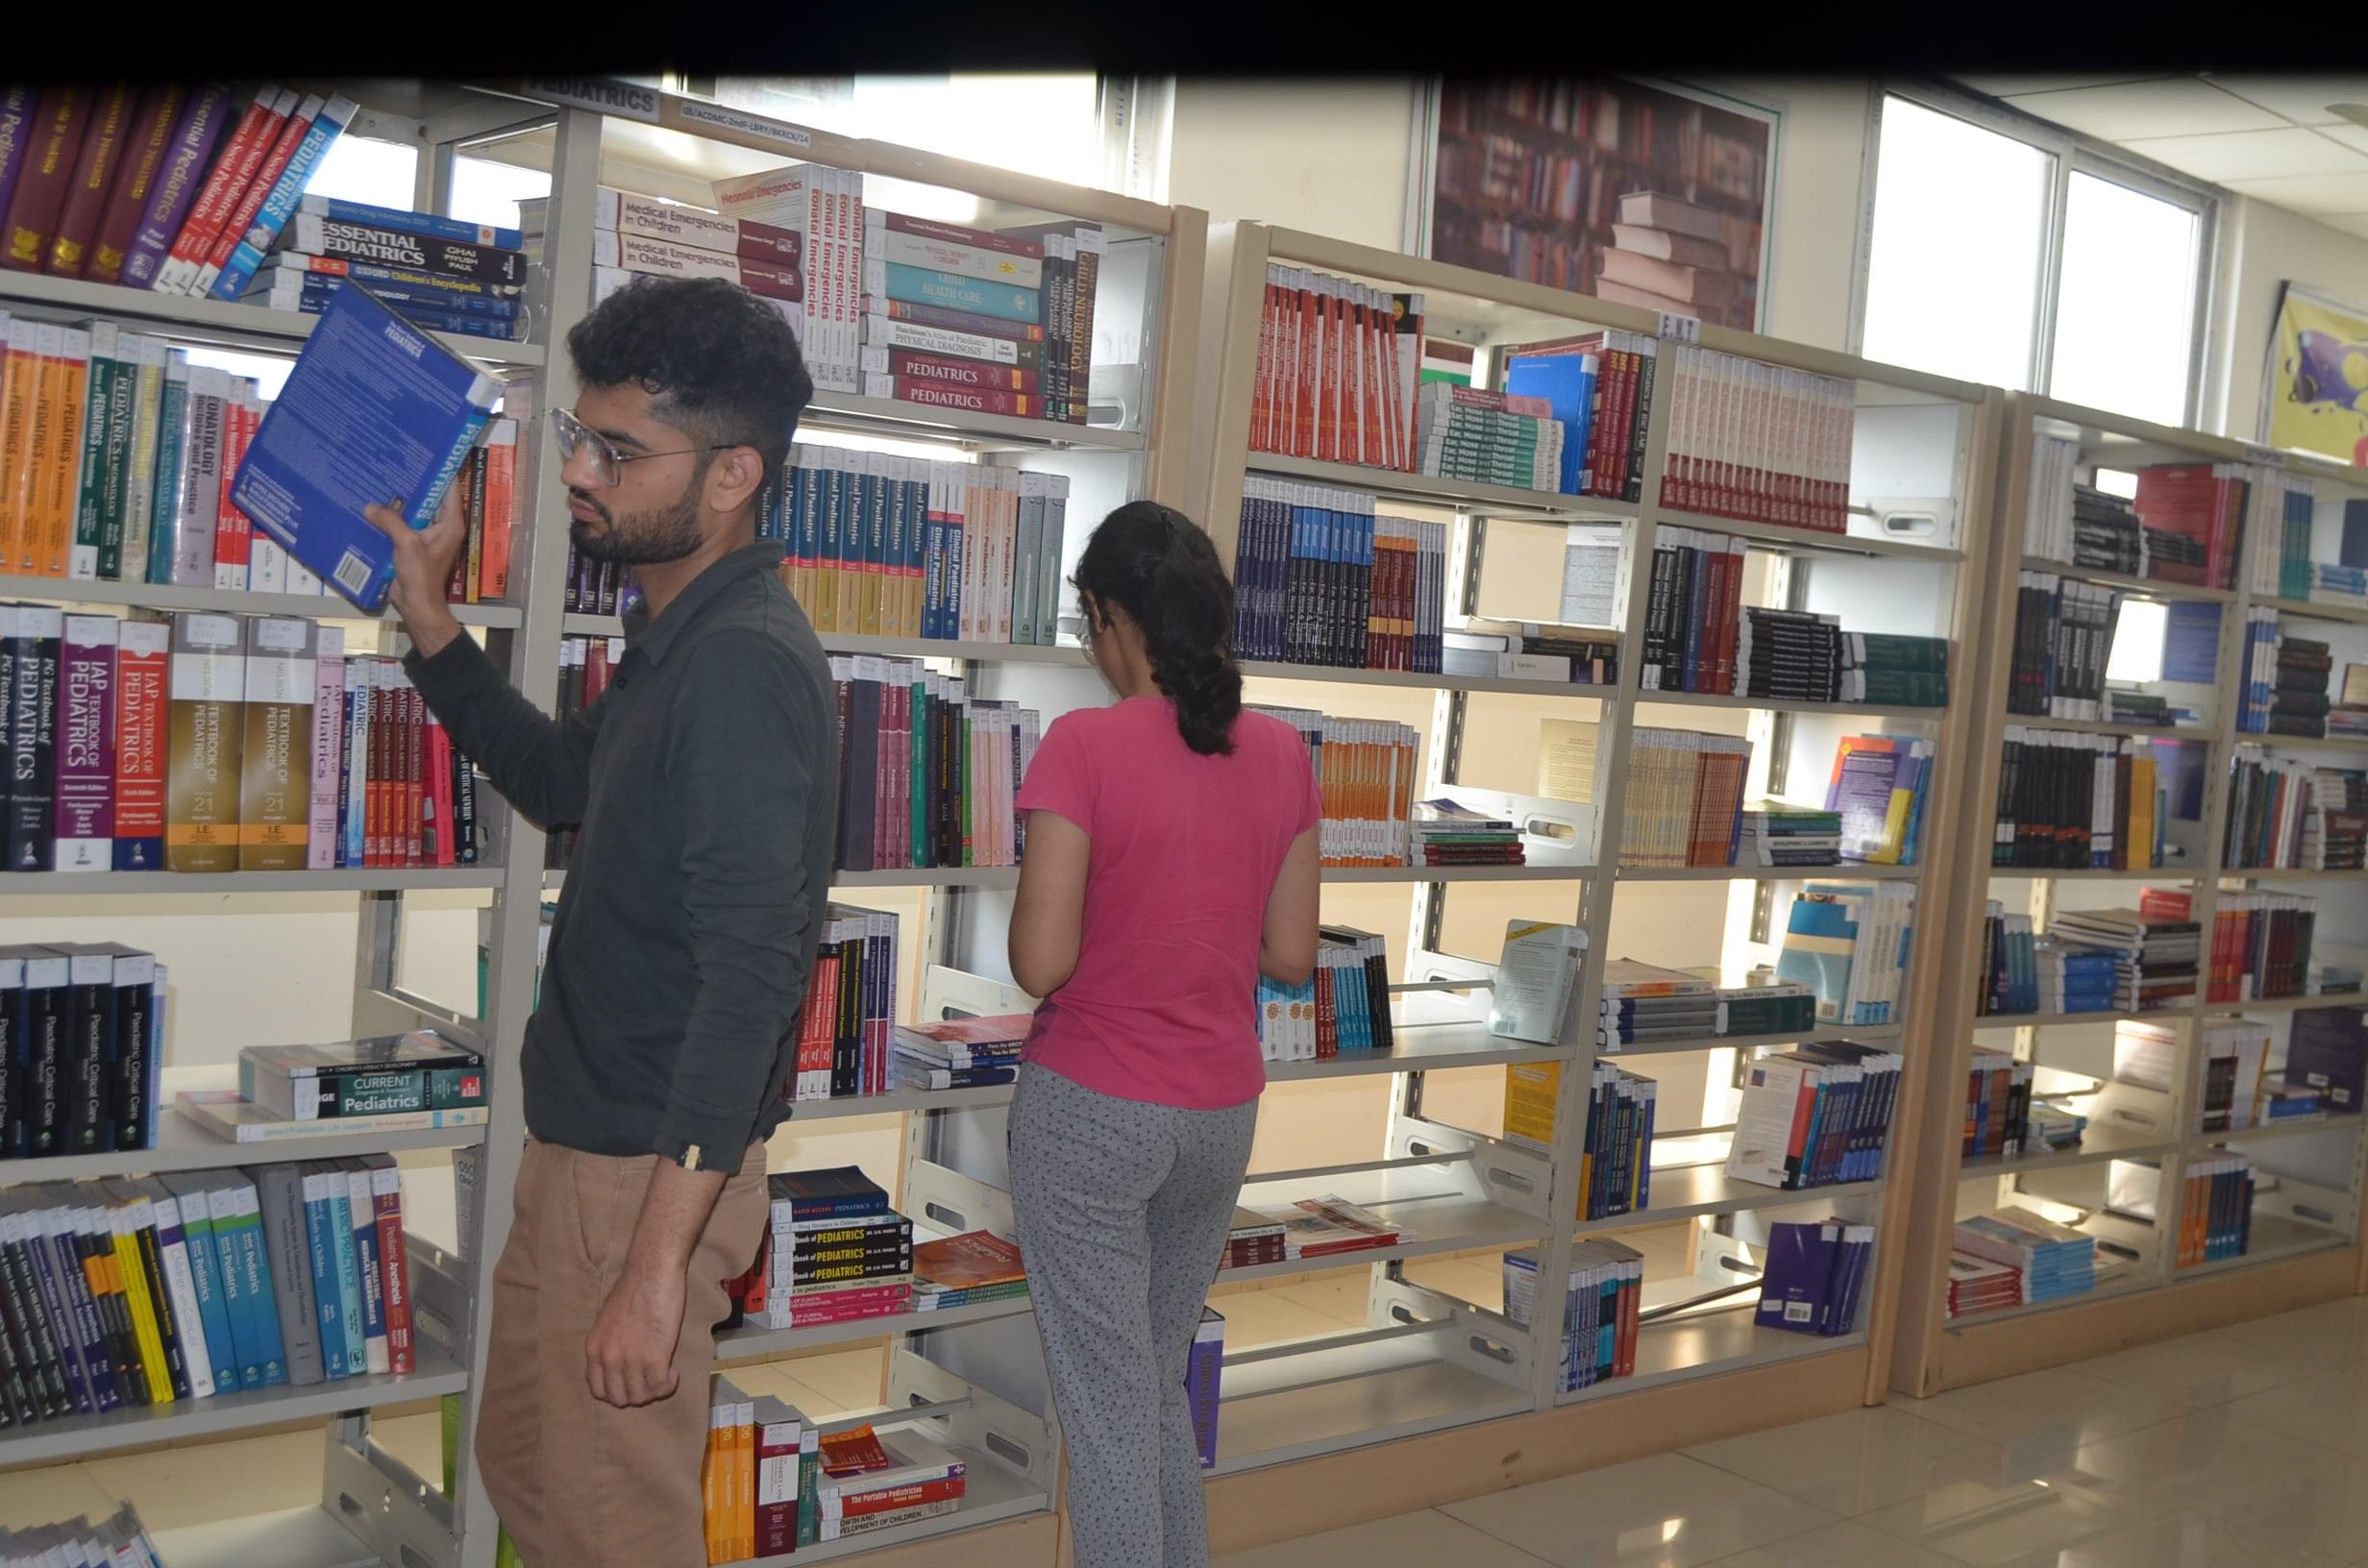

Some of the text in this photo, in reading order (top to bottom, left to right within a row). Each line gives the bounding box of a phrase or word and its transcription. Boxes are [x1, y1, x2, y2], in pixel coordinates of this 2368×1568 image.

[155, 148, 198, 223] Pediatrics
[263, 128, 326, 216] PEDIATRICS
[626, 202, 736, 233] Medical Emergencies
[637, 216, 680, 234] Children
[326, 235, 425, 265] EDIATRICS
[627, 241, 736, 268] Medical Emergencies
[639, 255, 682, 270] Children
[806, 238, 819, 317] Emergencies
[822, 242, 832, 320] Emergencies
[835, 243, 847, 322] Emergencies
[850, 246, 860, 324] Emergencies
[1072, 294, 1087, 373] NEUROLOGY
[906, 362, 978, 382] PEDIATRICS
[90, 394, 107, 446] PEDIATRICS
[911, 388, 983, 408] PEDIATRICS
[60, 404, 76, 462] PEDIATRICS
[201, 395, 220, 477] EONATOLOGY
[44, 659, 55, 675] PG
[144, 673, 160, 698] IAP
[17, 657, 40, 780] PEDIATRICS
[68, 661, 89, 768] PEDIATRICS
[86, 661, 108, 768] IAP TEXTBOOK OF
[124, 673, 142, 774] PEDIATRICS
[317, 685, 332, 778] Pediatrics
[355, 685, 366, 736] EDIATRIC
[194, 705, 206, 769] PEDIATRICS
[208, 705, 219, 784] TEXTBOOK OF
[266, 707, 278, 771] PEDIATRICS
[279, 708, 291, 785] TEXTBOOK OF
[345, 1095, 419, 1112] Pediatrics
[354, 1076, 412, 1090] CURRENT
[817, 1229, 865, 1244] PEDIATRICS
[817, 1248, 864, 1262] PEDIATRICS
[389, 1262, 399, 1306] Anesthesia
[816, 1263, 864, 1280] PEDIATRICS
[851, 1486, 923, 1505] The Portable Pediatrician
[858, 1513, 876, 1522] AND
[840, 1510, 922, 1534] VELOPMENT OF CHILDREN
